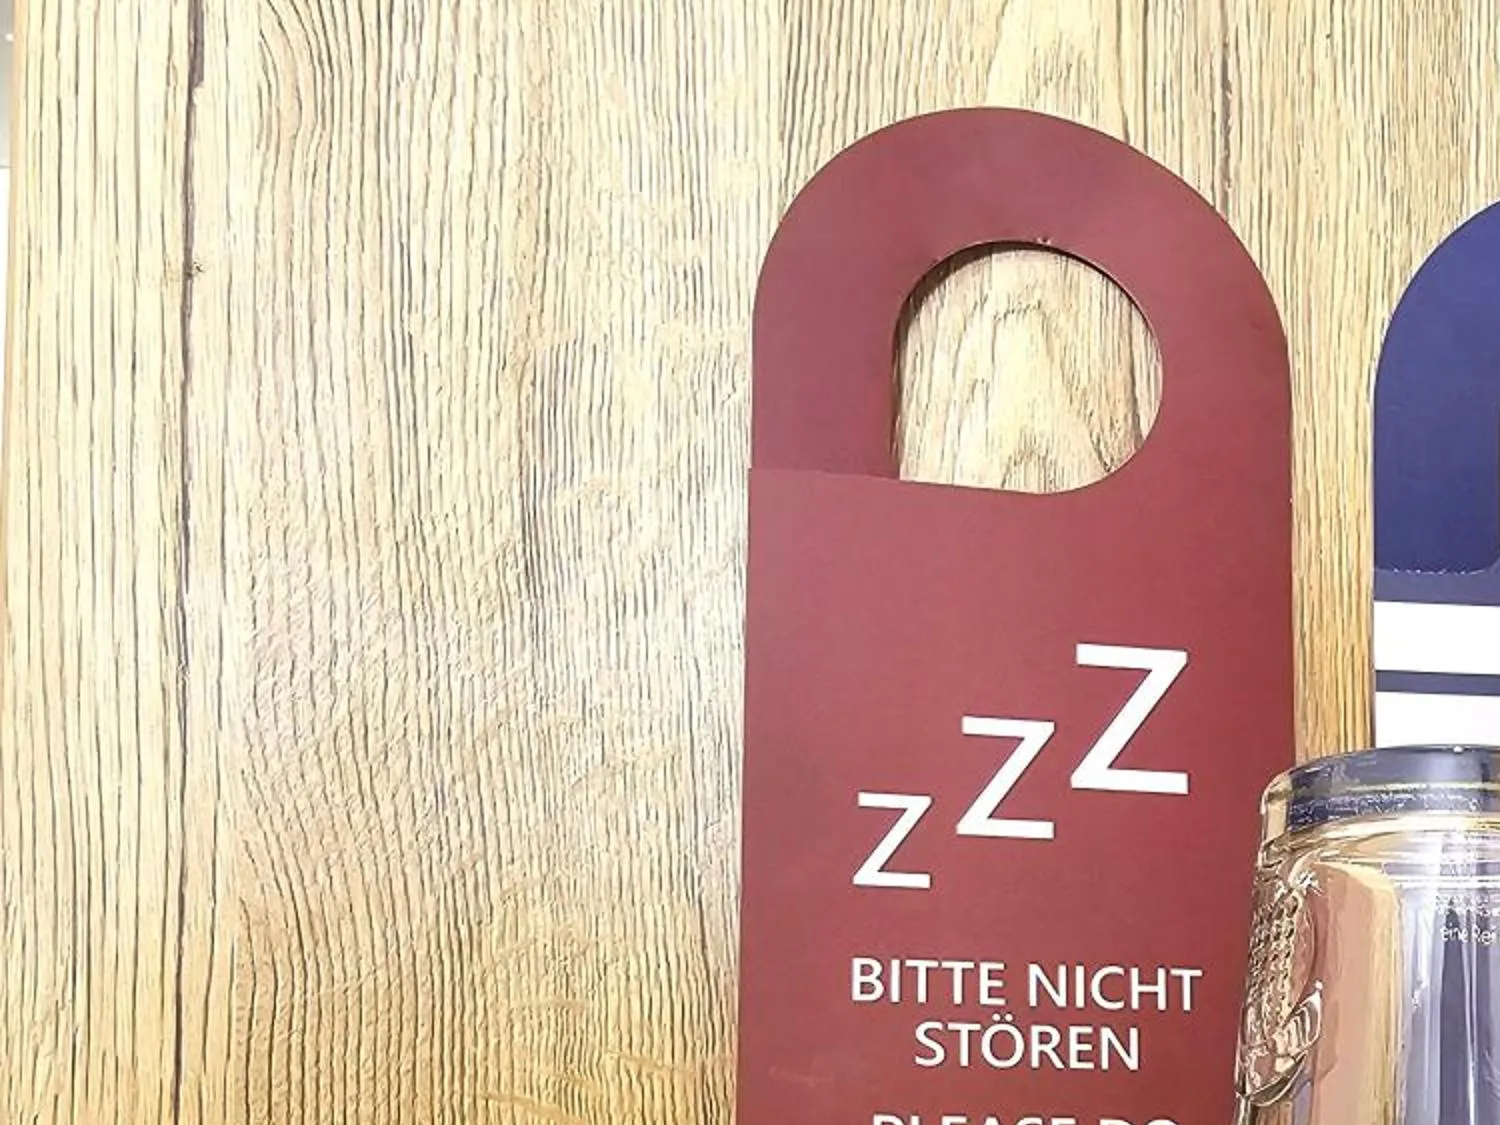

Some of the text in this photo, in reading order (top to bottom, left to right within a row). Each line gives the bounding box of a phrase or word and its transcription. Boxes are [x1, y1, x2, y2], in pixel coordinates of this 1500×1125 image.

[851, 957, 1203, 1011] BITTE NICHT
[914, 1013, 1140, 1071] STÖREN
